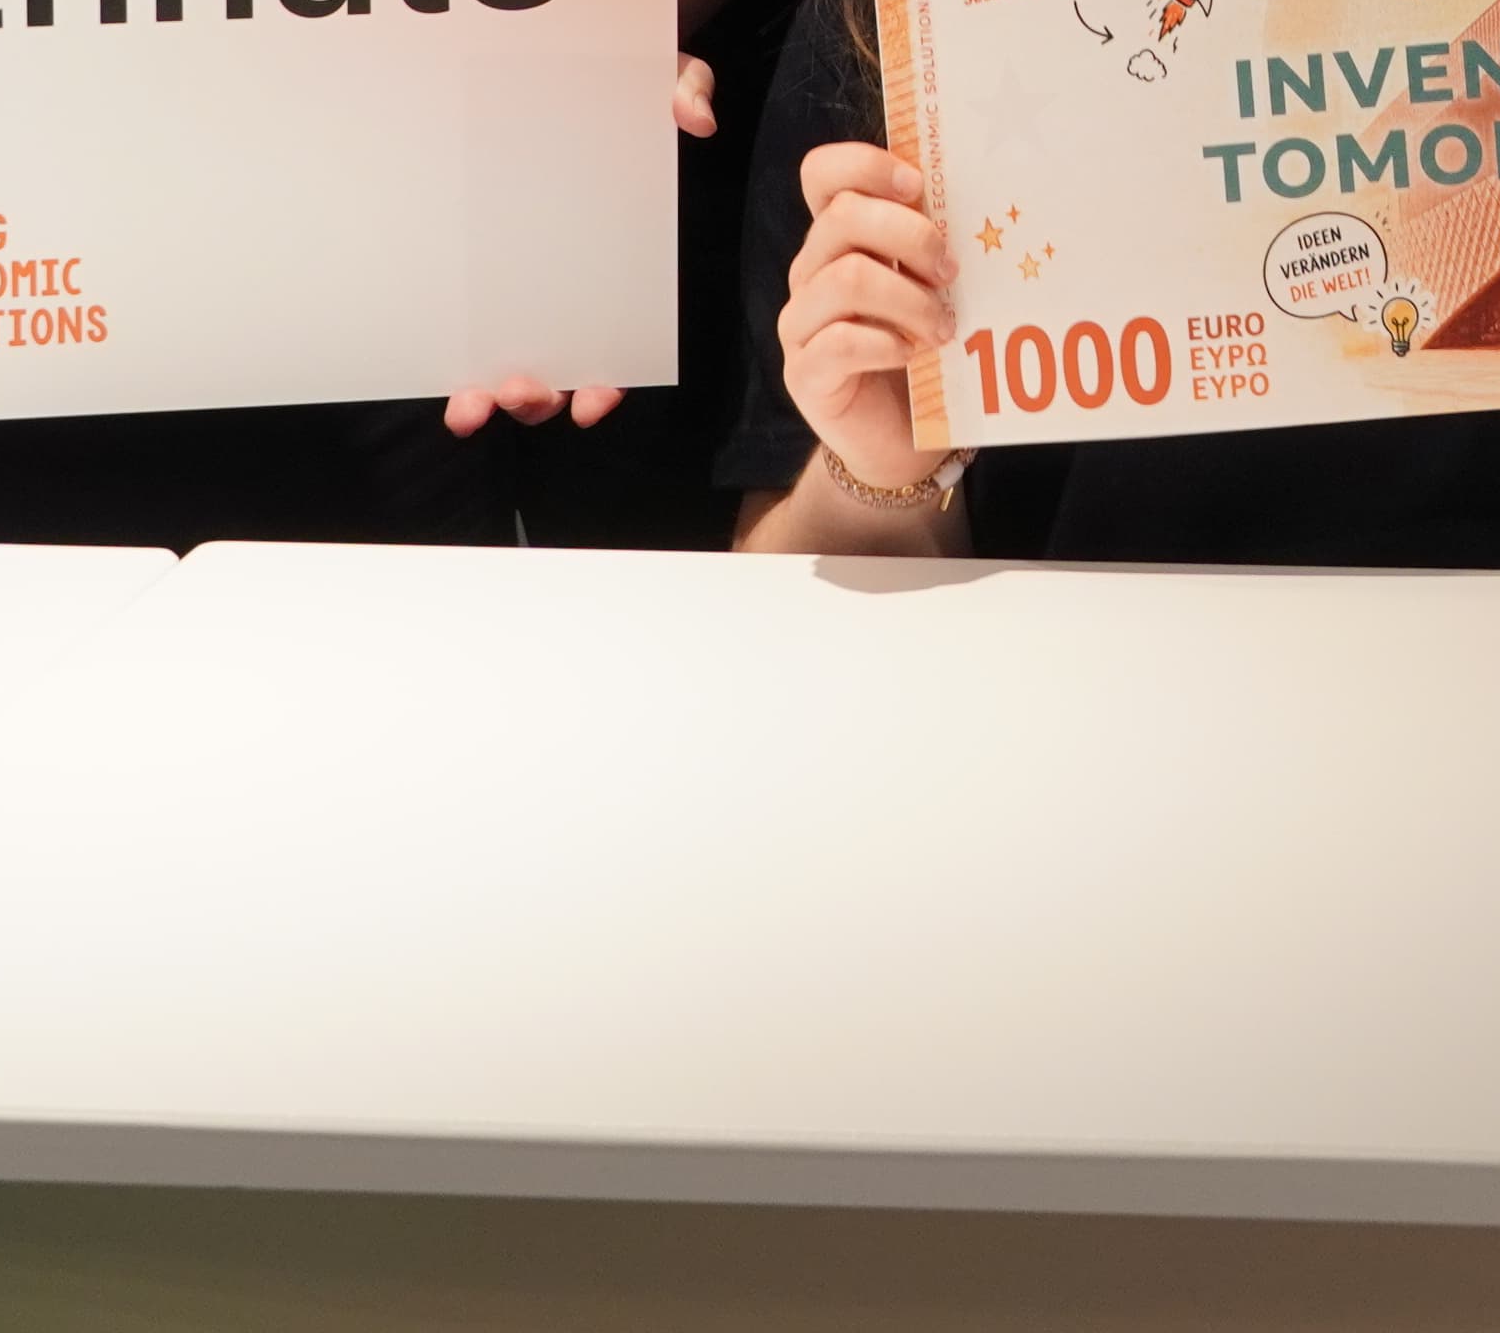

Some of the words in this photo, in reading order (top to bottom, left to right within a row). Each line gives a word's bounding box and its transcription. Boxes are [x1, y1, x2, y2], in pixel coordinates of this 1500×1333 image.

[1297, 225, 1342, 251] IDEEN
[1280, 243, 1370, 280] VERÄNDERN
[1290, 281, 1318, 304] DIE
[1322, 266, 1372, 295] WELT!
[1187, 312, 1265, 341] EURO
[964, 315, 1172, 416] 1000
